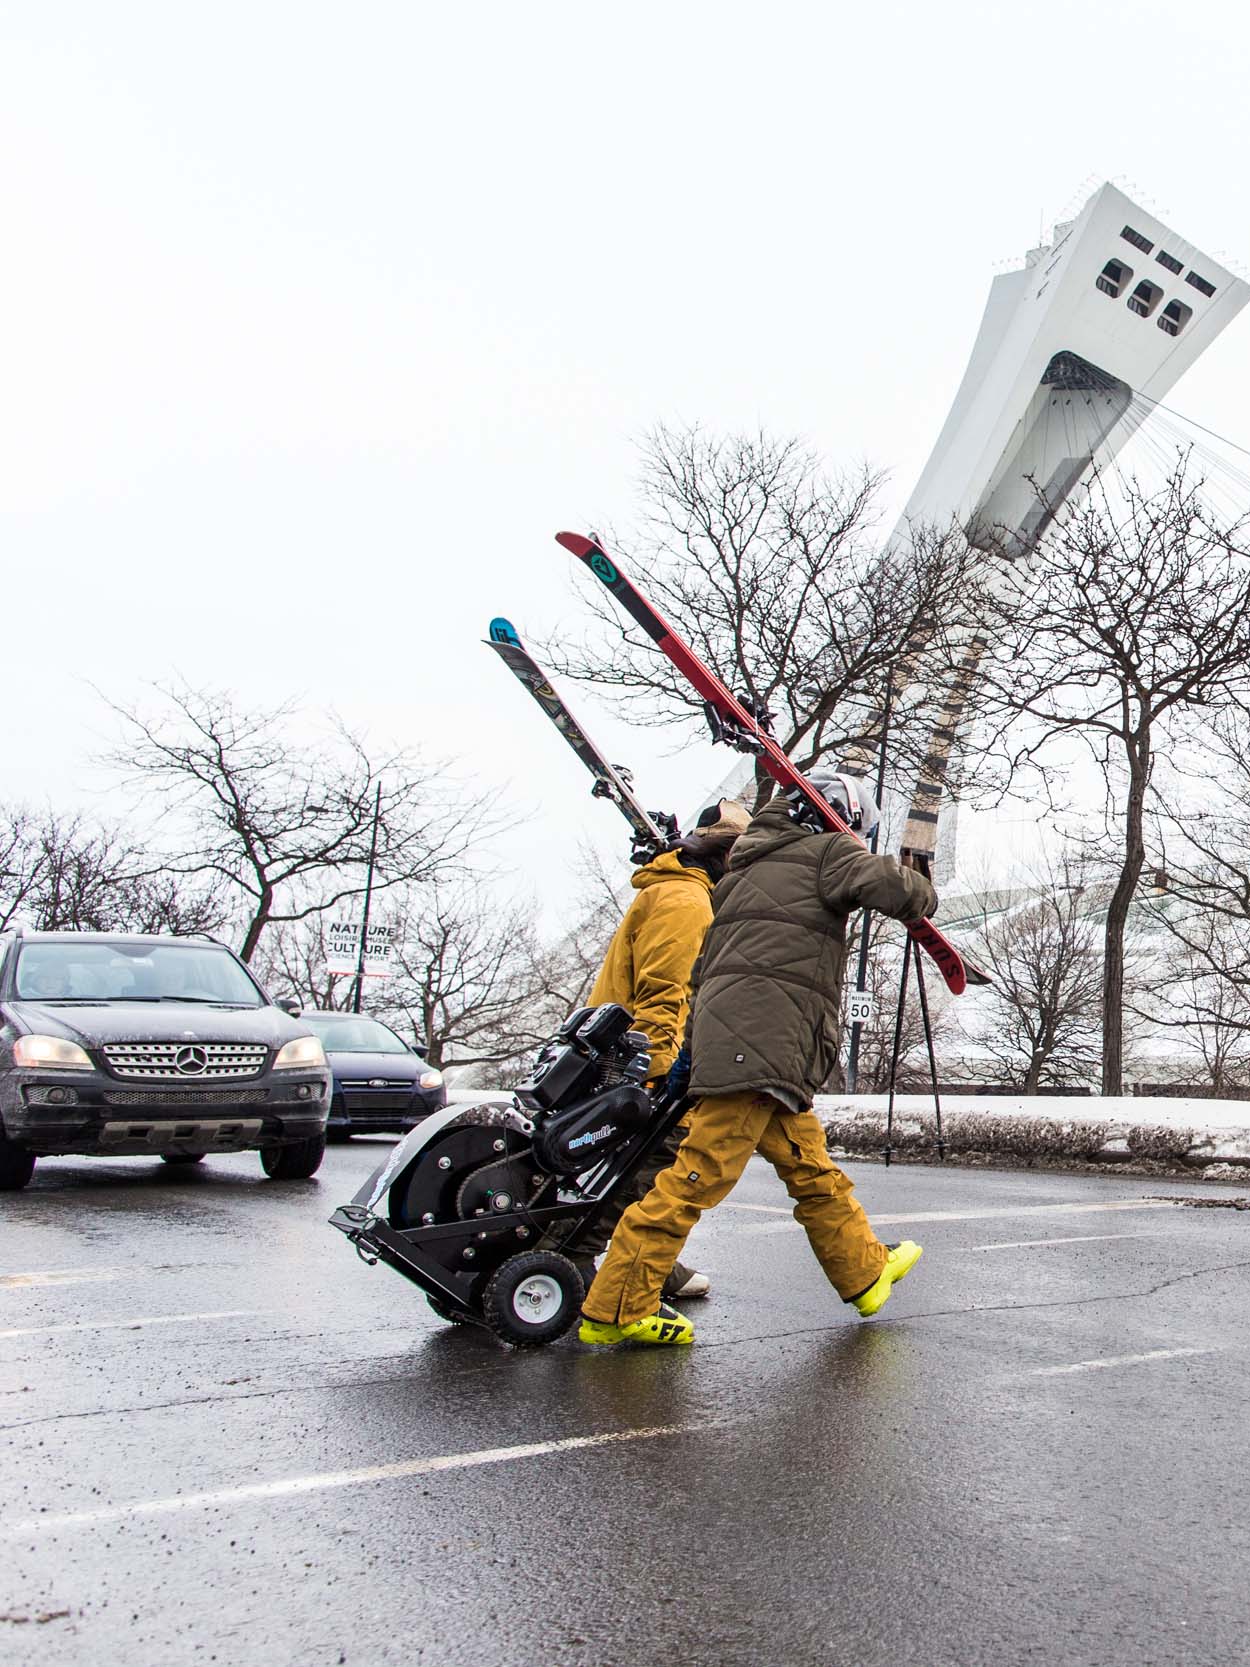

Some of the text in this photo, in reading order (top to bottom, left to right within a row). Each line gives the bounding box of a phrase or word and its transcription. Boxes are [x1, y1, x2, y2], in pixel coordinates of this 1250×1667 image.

[330, 923, 395, 937] NATURE
[850, 1004, 870, 1018] 50
[658, 1322, 686, 1342] FT
